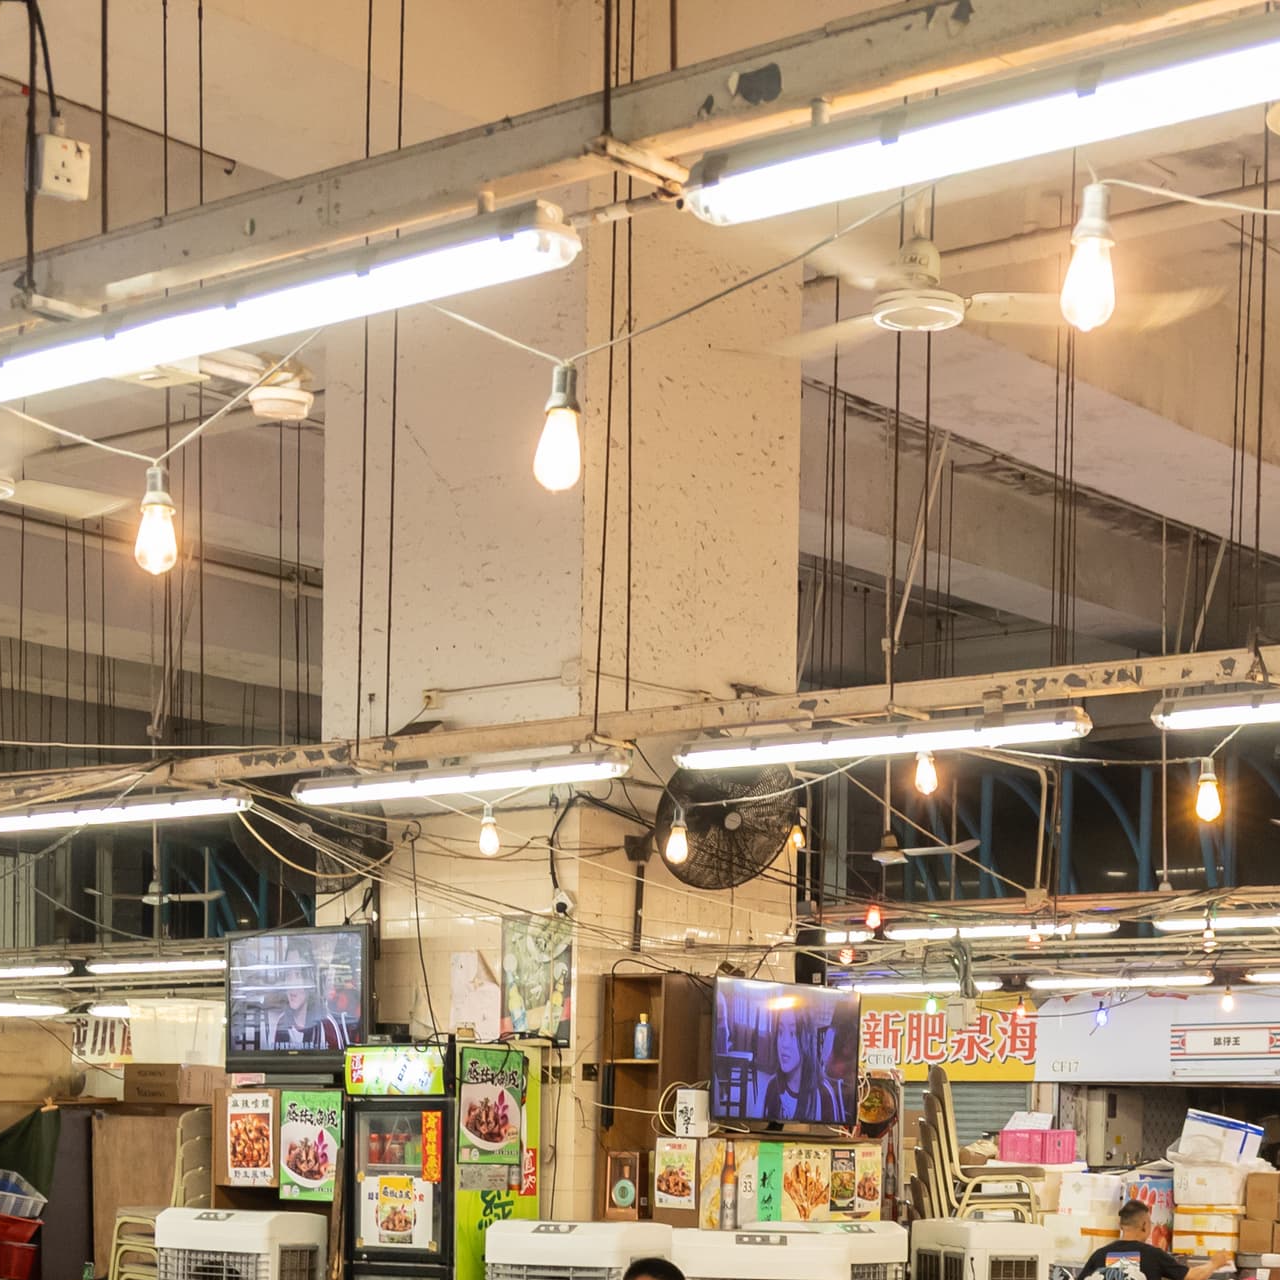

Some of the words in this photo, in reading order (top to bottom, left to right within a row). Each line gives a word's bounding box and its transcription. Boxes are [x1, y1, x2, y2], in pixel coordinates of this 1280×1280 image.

[862, 1010, 1037, 1065] 新肥泉海
[867, 1053, 893, 1066] CF16
[1052, 1061, 1079, 1074] CF17
